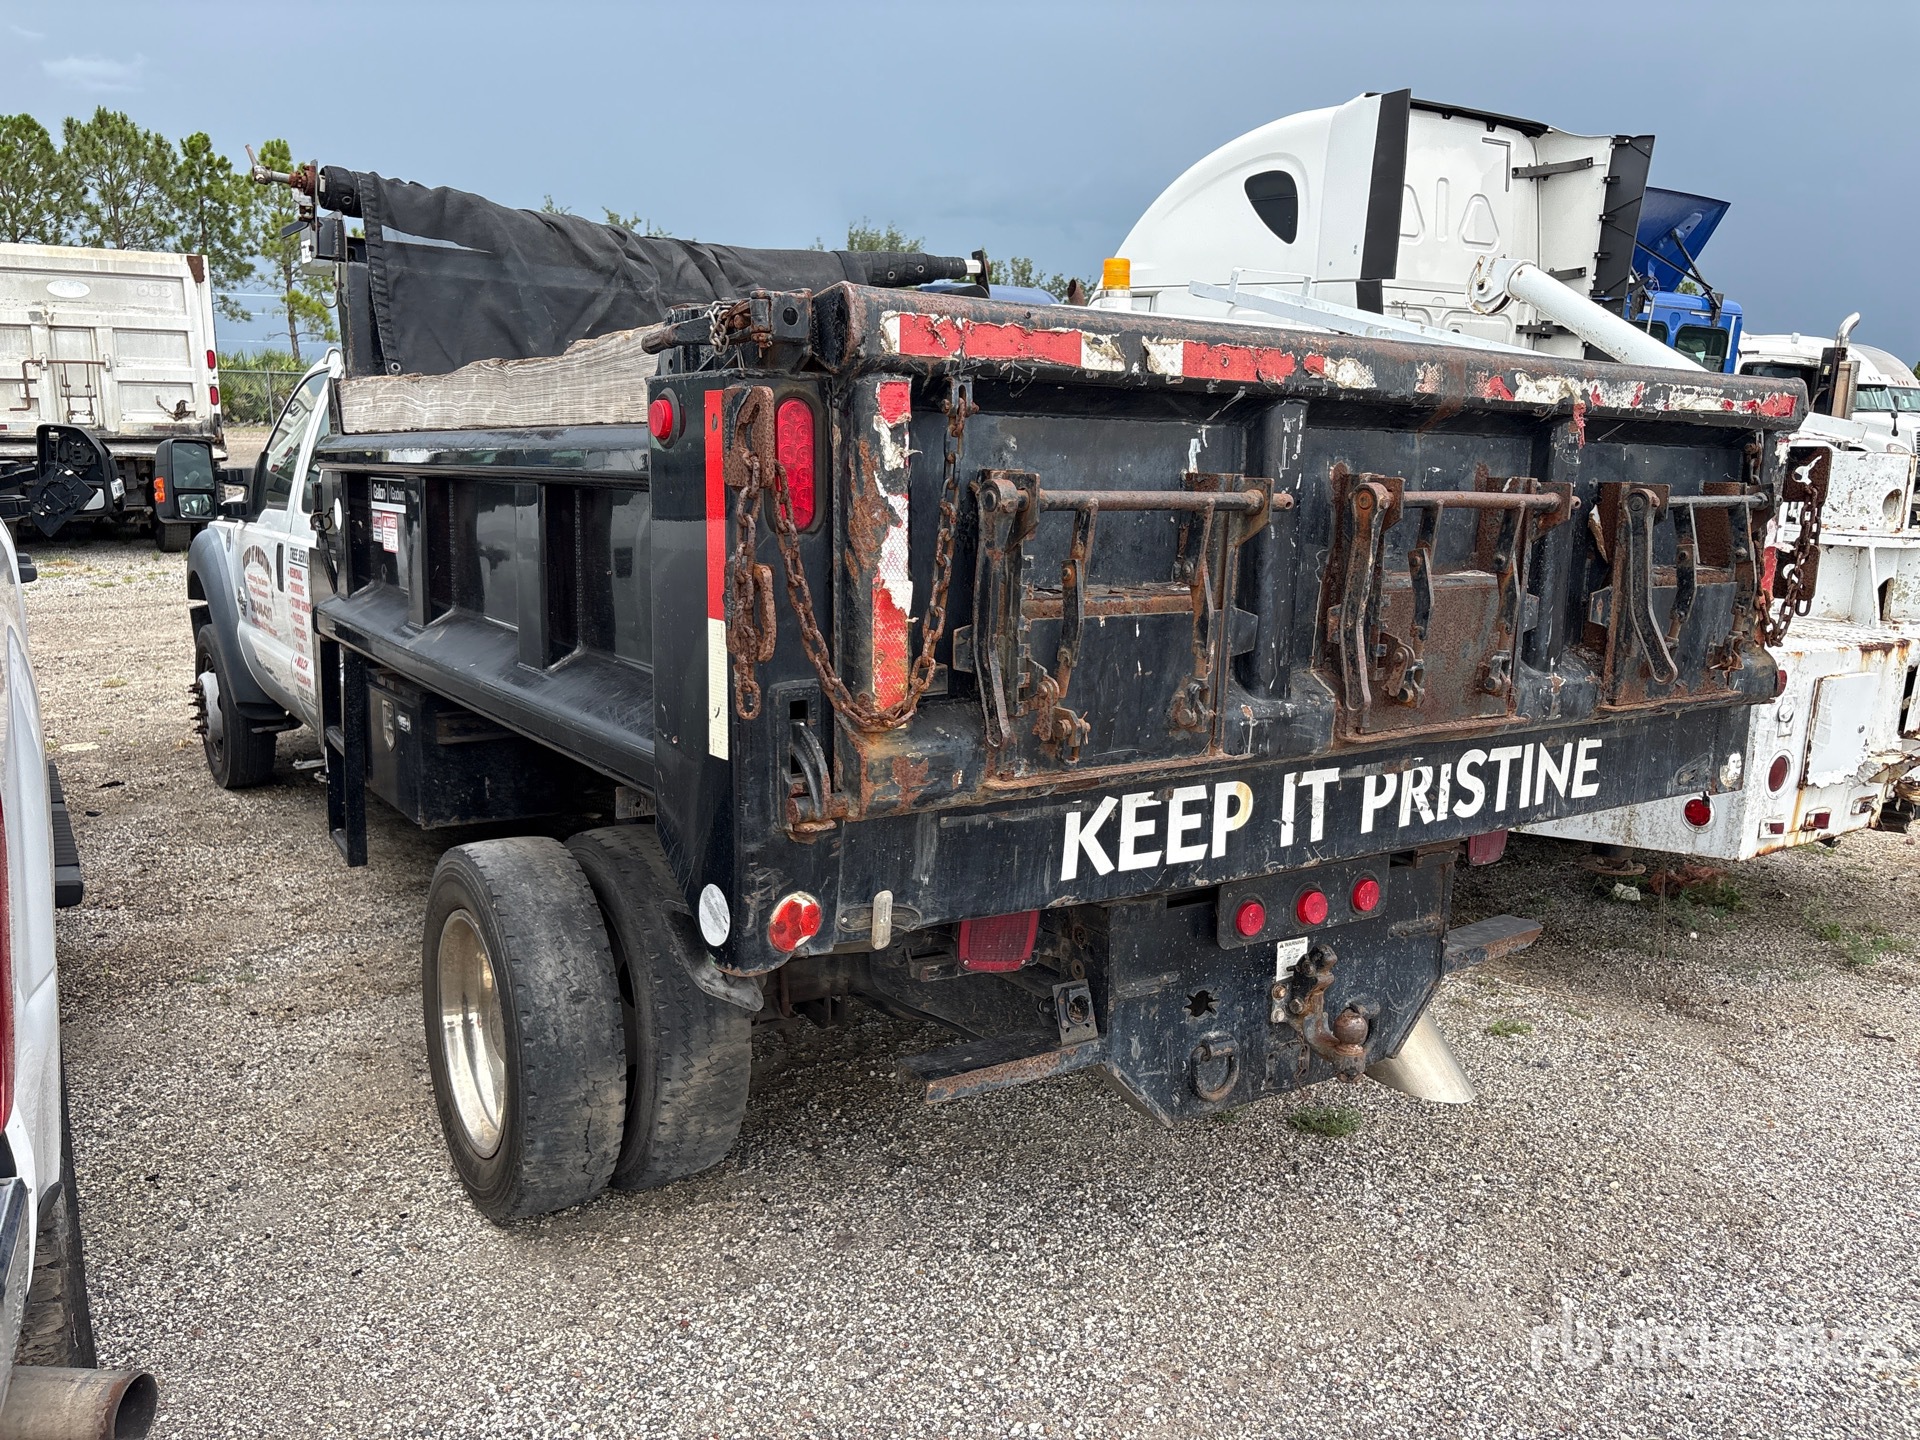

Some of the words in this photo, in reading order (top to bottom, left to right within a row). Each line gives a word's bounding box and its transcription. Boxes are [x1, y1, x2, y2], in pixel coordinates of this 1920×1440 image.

[1061, 781, 1254, 881] KEEP
[1280, 767, 1340, 847] IT
[1360, 738, 1602, 834] PRISTINE
[1285, 939, 1306, 948] WARNING
